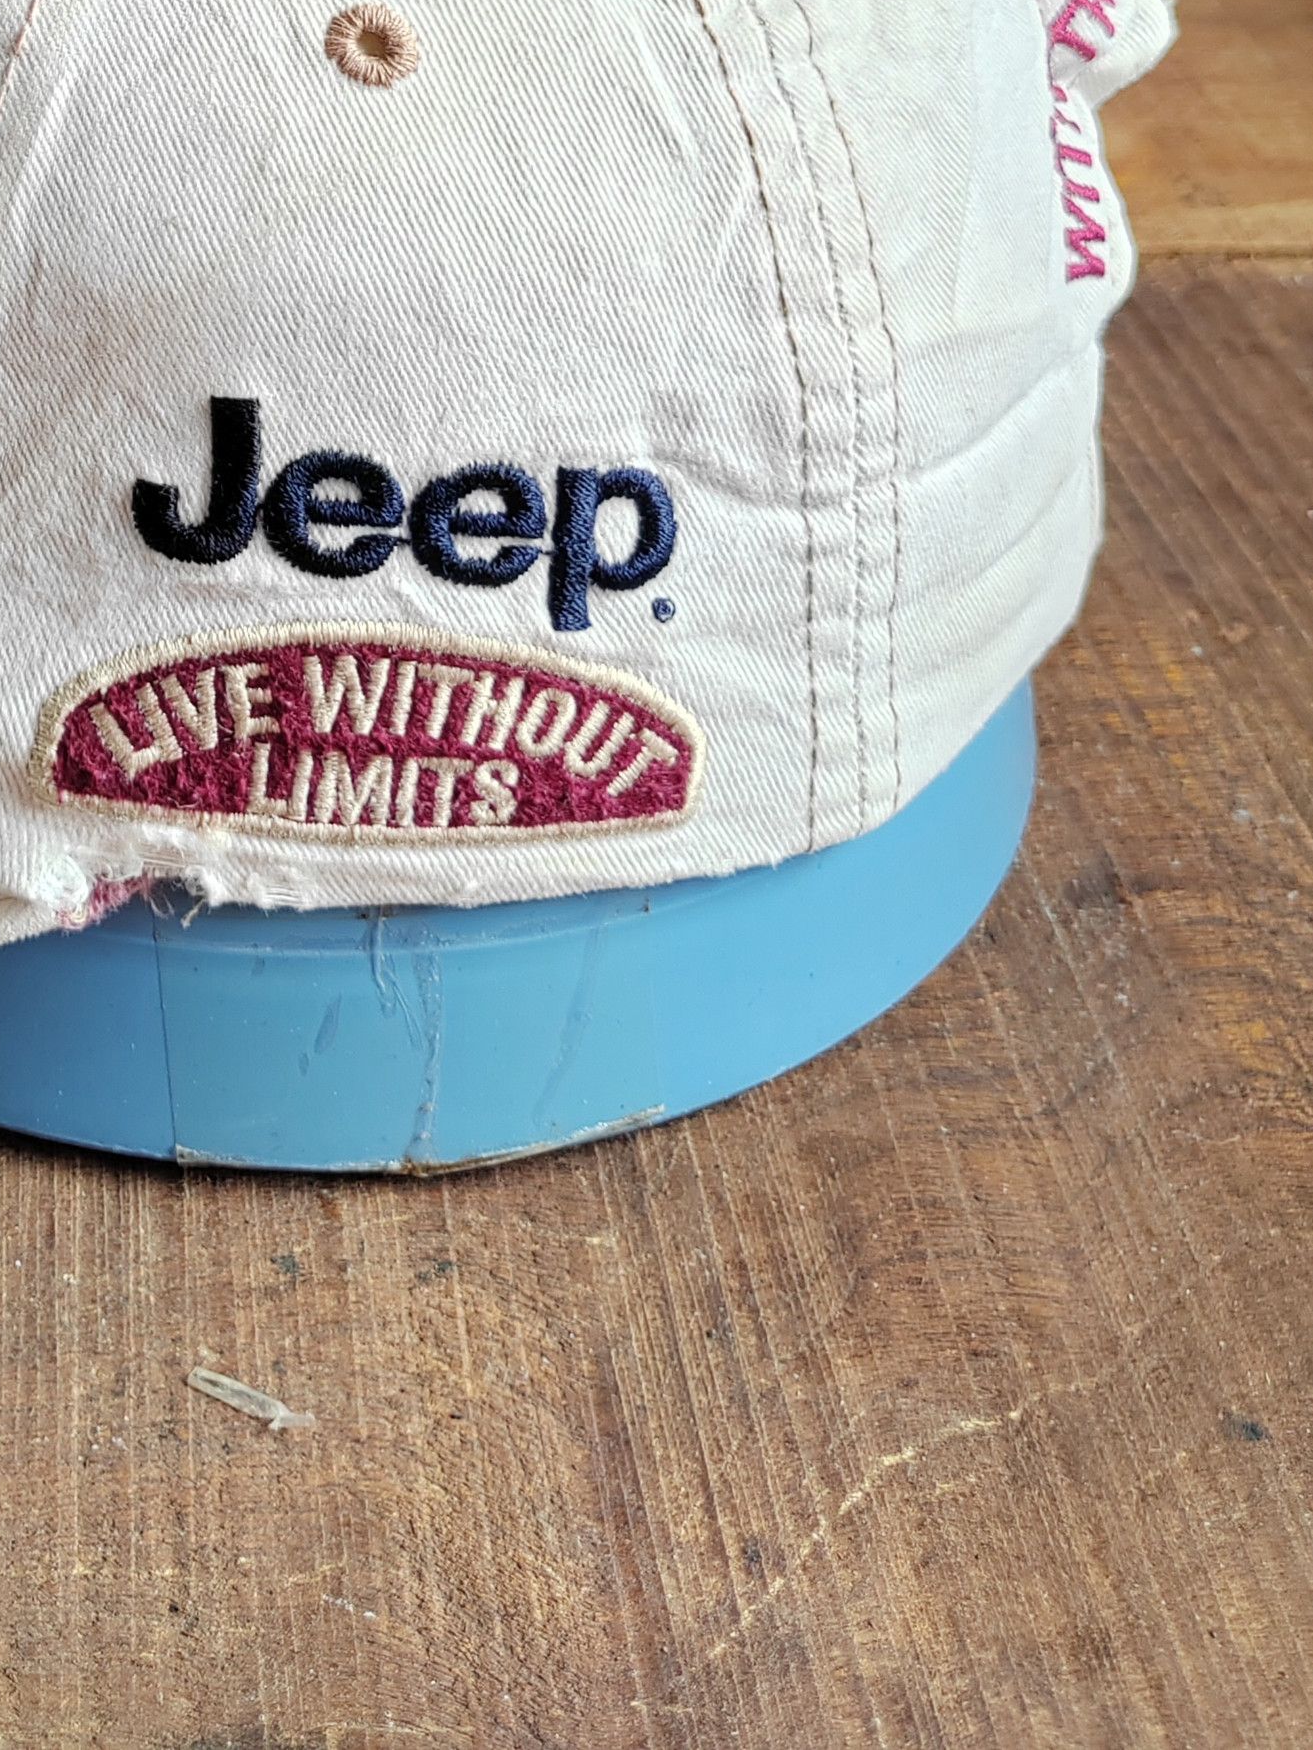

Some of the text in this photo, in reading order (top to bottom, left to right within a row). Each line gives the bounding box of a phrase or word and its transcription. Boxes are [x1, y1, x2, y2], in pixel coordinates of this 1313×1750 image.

[131, 396, 677, 632] Jeep
[90, 654, 679, 797] LIVE WITHOUT
[246, 743, 520, 828] LIMITS
